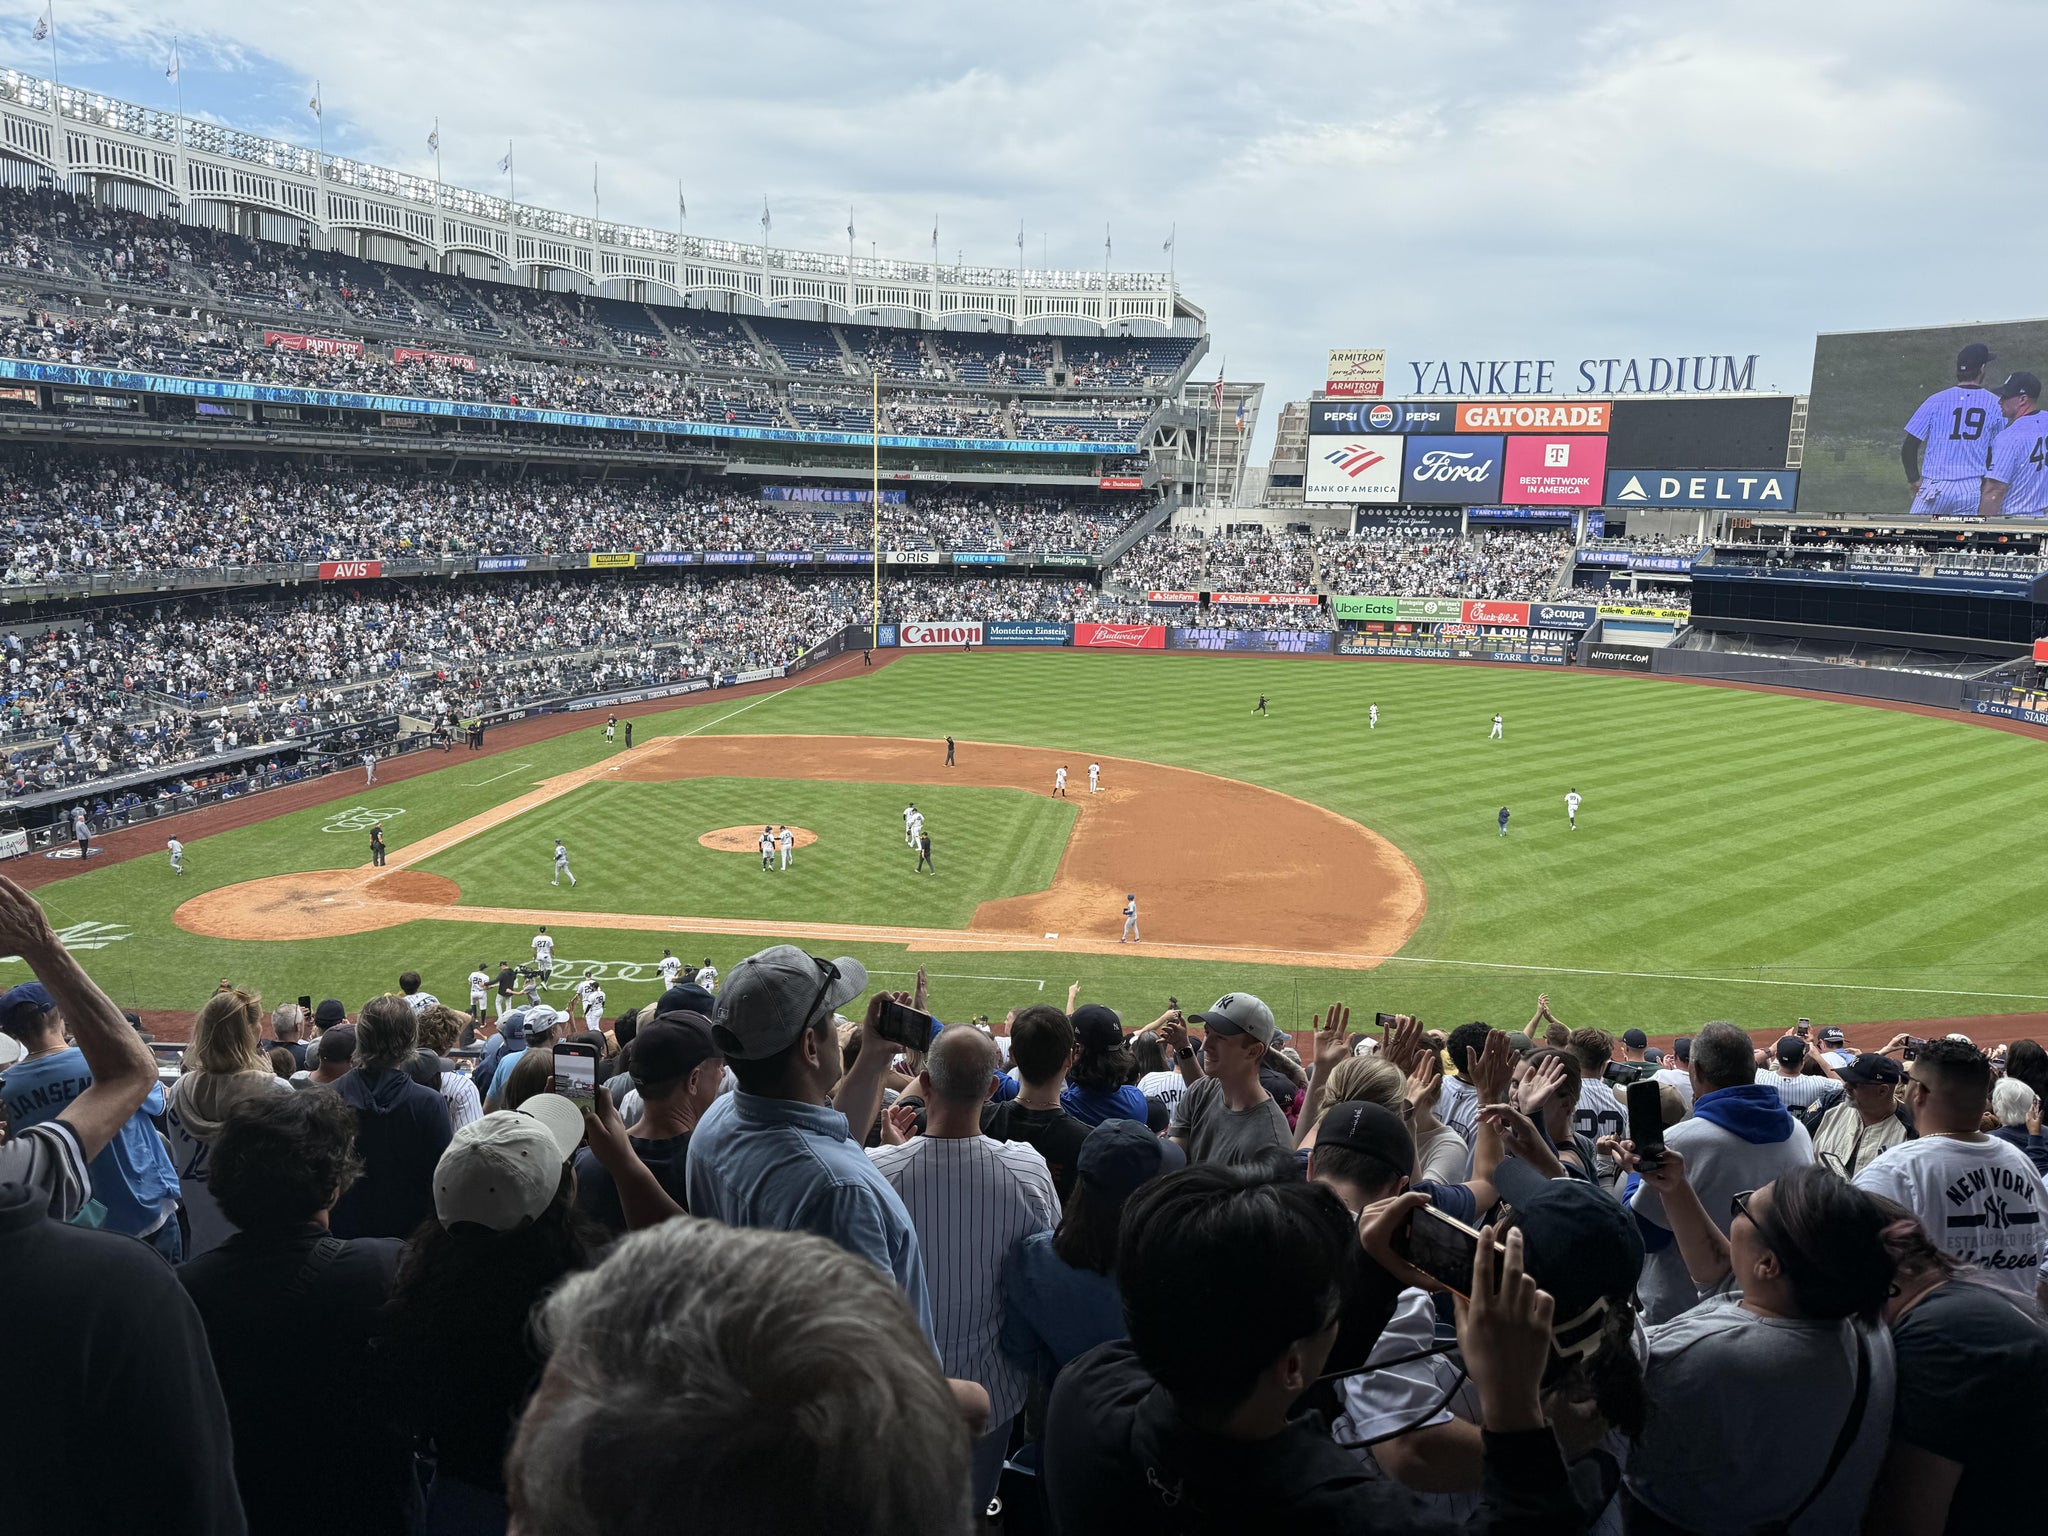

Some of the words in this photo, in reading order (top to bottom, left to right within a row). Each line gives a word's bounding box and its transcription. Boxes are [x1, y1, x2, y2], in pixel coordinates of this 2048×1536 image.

[1330, 353, 1383, 362] ARMITRON
[1408, 360, 1555, 395] YANKEE
[1577, 354, 1760, 393] STADIUM
[145, 377, 216, 395] YANKEES
[222, 384, 255, 398] WIN
[1331, 382, 1379, 390] ARMITRON
[366, 397, 424, 412] YANKEES
[428, 402, 452, 414] WIN
[537, 410, 582, 424] YANKEES
[586, 416, 606, 428] WIN
[1324, 412, 1357, 422] PEPSI
[1371, 412, 1392, 420] PEPSI
[1406, 412, 1440, 422] PEPSI
[1465, 407, 1602, 426] GATORADE
[1950, 407, 1986, 440] 19
[686, 424, 735, 436] YANKEES
[739, 428, 760, 439] WIN
[894, 436, 918, 448] WIN
[1002, 441, 1051, 452] YANKEES
[1056, 442, 1080, 452] WIN
[1414, 450, 1493, 482] Ford
[1520, 477, 1542, 485] BEST
[1543, 478, 1590, 486] NETWORK
[1527, 486, 1536, 494] IN
[1538, 486, 1580, 494] AMERICA
[1660, 478, 1783, 500] DELTA
[782, 488, 850, 502] YANKEES
[1732, 518, 1750, 528] 0:08
[646, 554, 677, 564] YANKEES
[678, 554, 694, 564] WIN
[704, 552, 739, 564] YANKEES
[740, 552, 756, 562] WIN
[766, 552, 797, 562] YANKEES
[798, 553, 814, 562] WIN
[825, 552, 858, 563] YANKEES
[860, 553, 874, 562] WIN
[896, 552, 929, 564] ORIS
[954, 554, 988, 564] YANKEES
[990, 554, 1006, 564] WIN
[1044, 556, 1064, 564] Poland
[1065, 556, 1087, 566] Spring
[1580, 552, 1628, 562] YANKEES
[478, 560, 508, 570] YANKEES
[510, 560, 526, 568] WIN
[1628, 558, 1679, 568] YANKEES
[334, 564, 367, 578] AVIS
[1336, 602, 1363, 614] Uber
[1365, 604, 1394, 614] Eats
[1600, 606, 1624, 615] Gillette
[1630, 608, 1656, 616] Gillette
[1470, 606, 1520, 623] Chick-fil-A
[1554, 610, 1584, 620] coupa
[1662, 610, 1687, 619] Gillette
[990, 626, 1034, 635] Montefiore
[1035, 627, 1066, 636] Einstein
[1440, 623, 1478, 632] Jersey
[902, 626, 980, 643] Canon
[1097, 630, 1144, 642] Budweiser
[1184, 629, 1239, 639] YANKEES
[1264, 631, 1320, 642] YANKEES
[1198, 639, 1226, 650] WIN
[1278, 641, 1306, 652] WIN
[1341, 646, 1375, 656] StubHub
[1378, 647, 1412, 656] StubHub
[1414, 648, 1450, 658] StubHub
[1494, 653, 1522, 661] STARR
[1592, 650, 1648, 664] NITTOTIRE.COM
[9, 1077, 92, 1120] JANSEN
[1155, 1090, 1186, 1104] DRI
[1946, 1168, 1986, 1207] NEW
[1990, 1167, 2034, 1204] YORK
[1946, 1234, 2016, 1249] ESTALISHED
